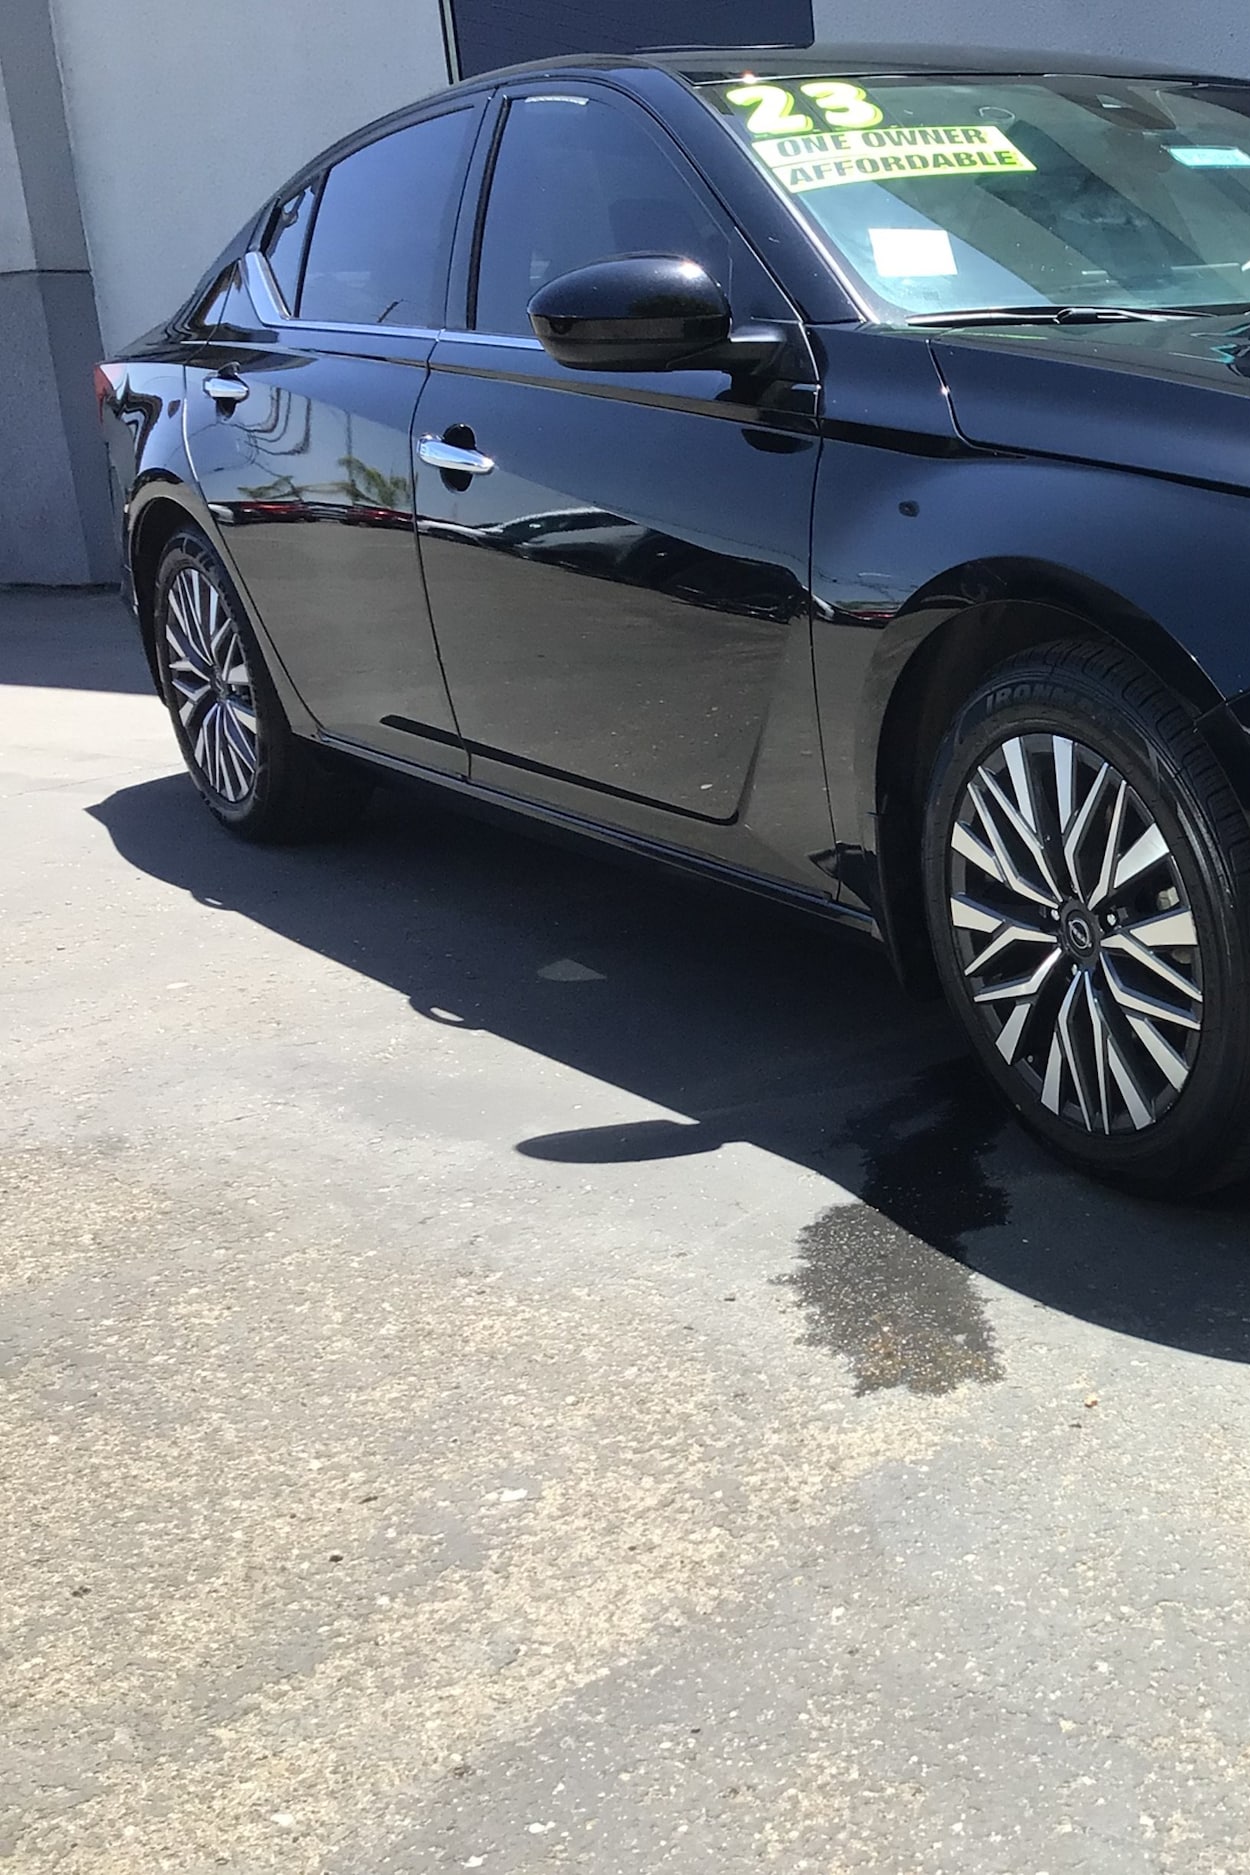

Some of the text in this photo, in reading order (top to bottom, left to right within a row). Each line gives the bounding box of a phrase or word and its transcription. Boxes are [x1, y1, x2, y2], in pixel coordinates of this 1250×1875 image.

[726, 81, 884, 134] 23
[776, 127, 988, 159] ONE OWNER
[789, 150, 1018, 186] AFFORDABLE
